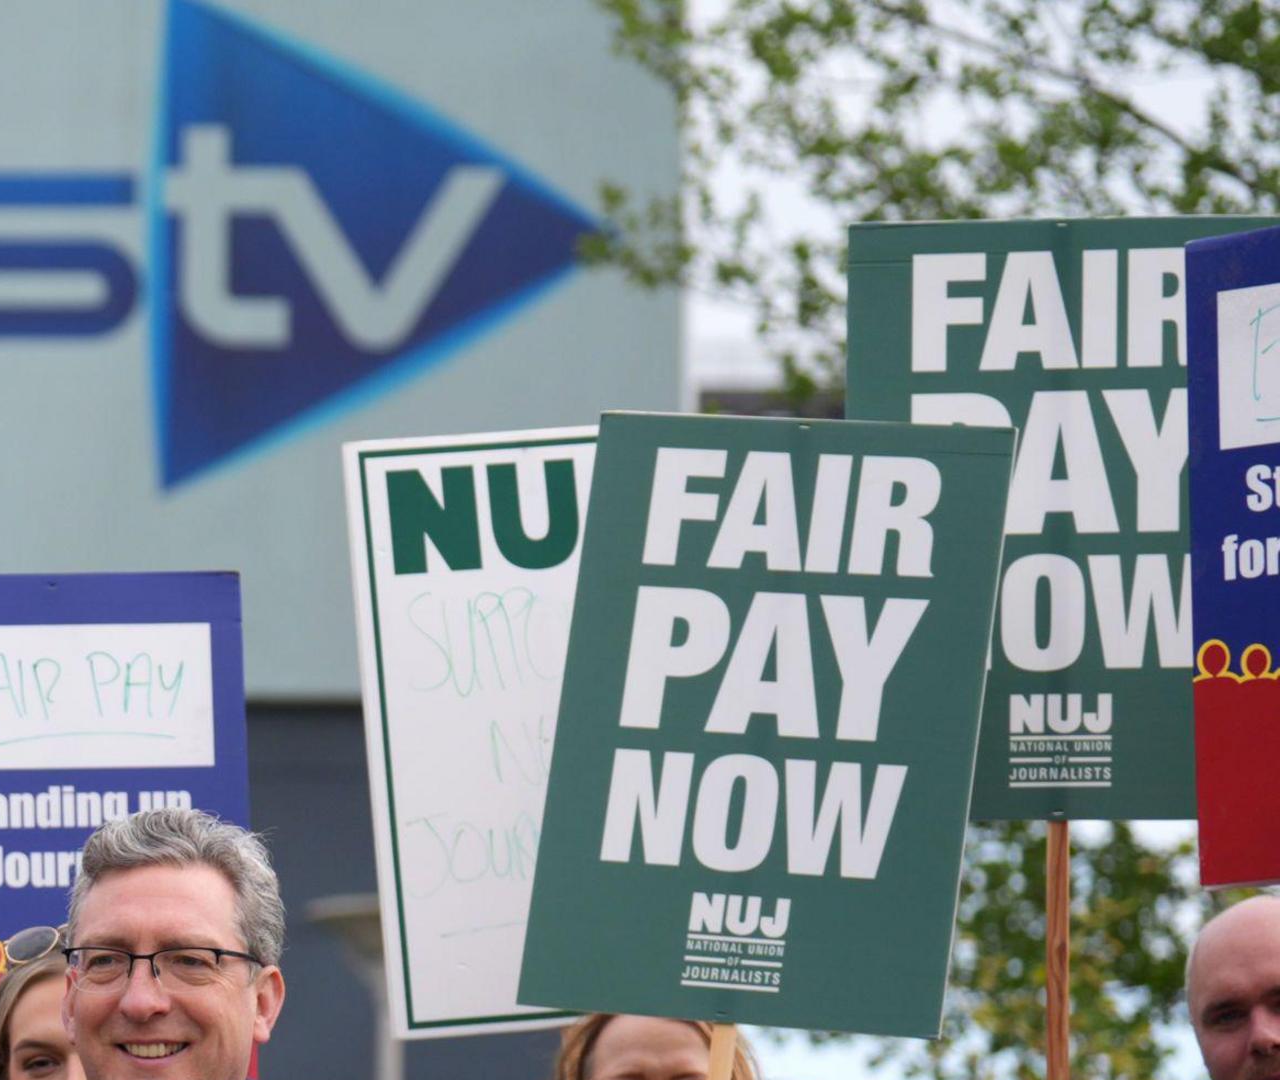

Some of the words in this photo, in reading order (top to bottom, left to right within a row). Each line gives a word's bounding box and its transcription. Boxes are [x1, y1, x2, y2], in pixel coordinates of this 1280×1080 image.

[911, 247, 1188, 372] FAIR
[385, 458, 581, 577] NU
[642, 447, 943, 577] FAIR
[986, 554, 1193, 672] OW
[86, 650, 184, 719] PAY
[619, 585, 929, 742] PAY
[1010, 693, 1113, 734] NUJ
[1010, 741, 1069, 752] NATIONAL
[1074, 741, 1112, 752] UNION
[1054, 755, 1067, 765] OF
[1009, 767, 1112, 780] JOURNALISTS
[600, 748, 908, 880] NOW
[688, 891, 792, 938] NUJ
[686, 940, 743, 954] NATIONAL
[748, 944, 784, 957] UNION
[727, 956, 740, 966] OF
[681, 965, 781, 985] JOURNALISTS
